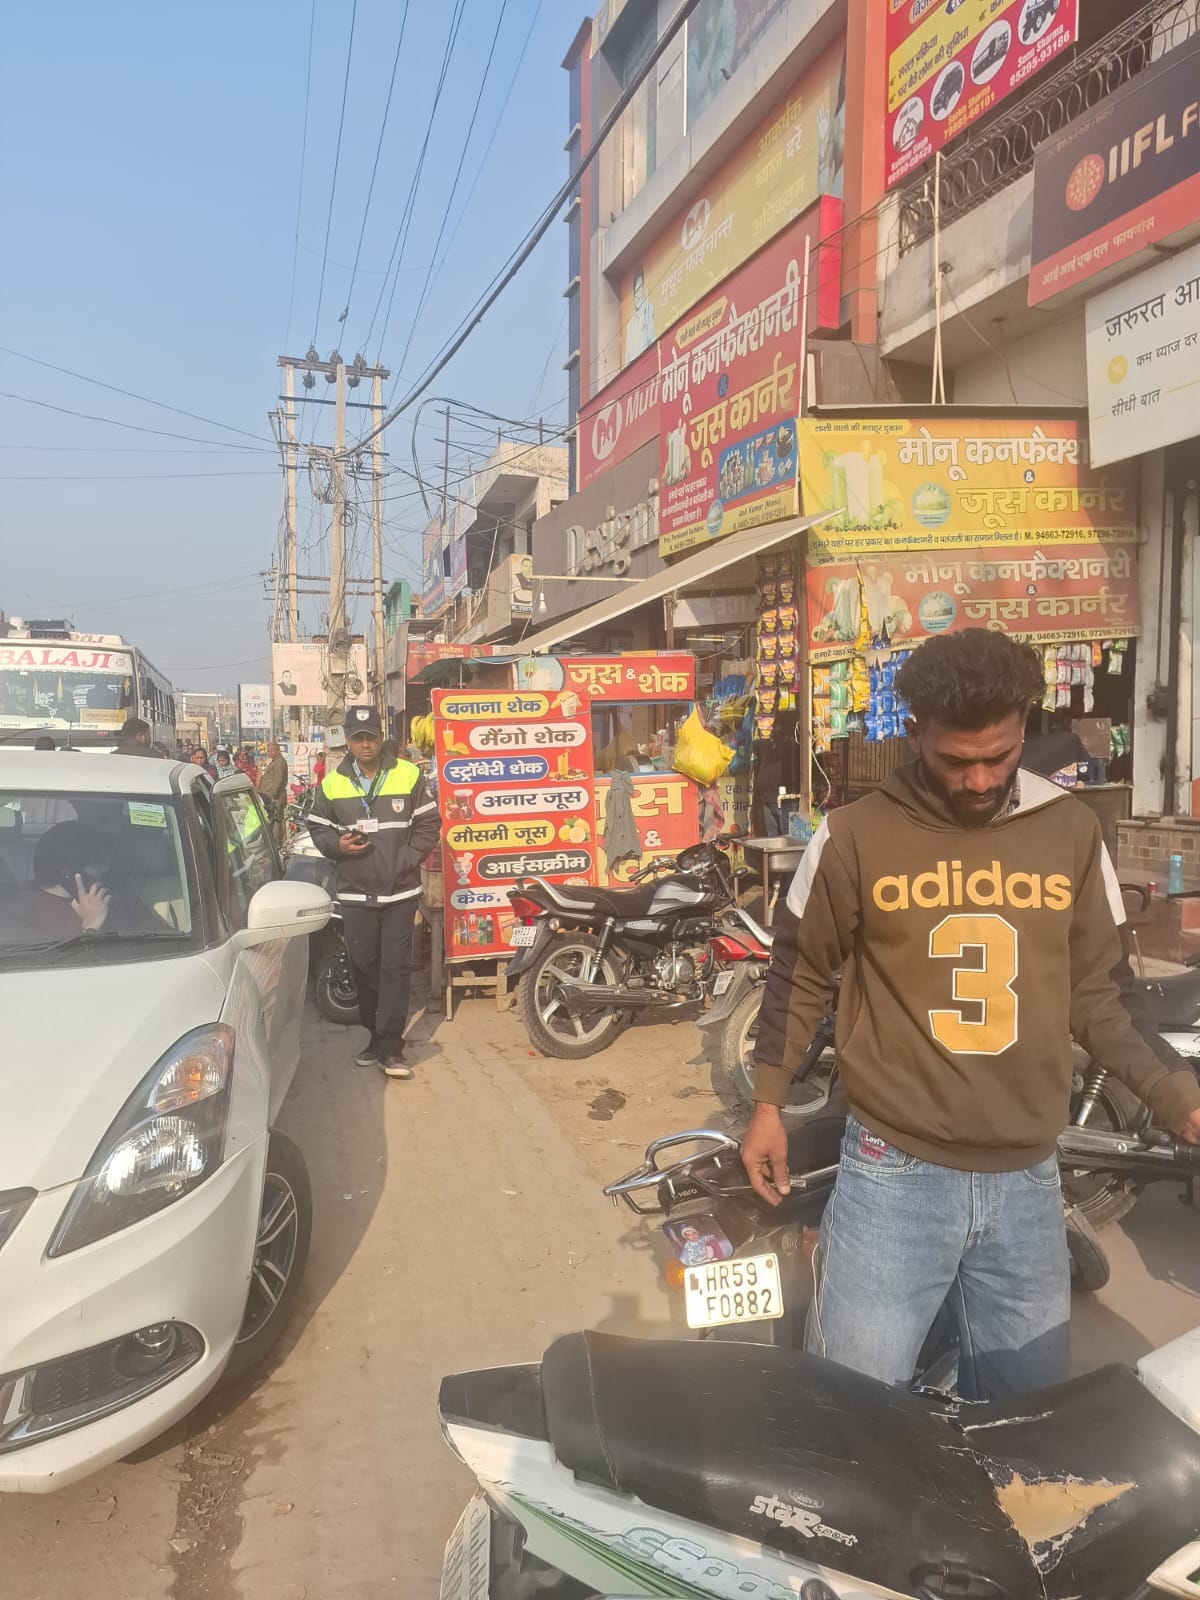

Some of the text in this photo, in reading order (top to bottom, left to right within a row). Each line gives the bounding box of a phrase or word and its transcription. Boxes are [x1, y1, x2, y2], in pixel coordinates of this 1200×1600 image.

[1108, 113, 1174, 185] IIFL
[1182, 101, 1199, 139] F
[1174, 276, 1200, 307] आ
[1136, 351, 1152, 367] कम
[1155, 339, 1181, 358] ब्याज
[661, 347, 693, 415] मोनू
[718, 374, 729, 397] &
[690, 352, 797, 469] जूस कार्नर
[1111, 387, 1162, 417] सीधी बात
[897, 426, 968, 481] मोनू
[1024, 470, 1035, 483] &
[956, 477, 1129, 529] जूस कार्नर
[1024, 532, 1034, 540] M.
[902, 554, 971, 595] मोनू
[1027, 585, 1036, 595] &
[962, 586, 1128, 632] जूस कार्नर
[567, 663, 690, 695] जूस & शेक
[445, 696, 542, 715] बनाना शेक
[479, 726, 577, 746] मैंगो शेक
[449, 759, 543, 782] स्ट्रॉबेरी शेक
[482, 791, 582, 809] अनार जूस
[453, 824, 547, 845] मौसमी जूस
[644, 830, 663, 847] &
[485, 853, 586, 875] आईसक्रीम
[872, 860, 1072, 912] adidas
[928, 913, 1018, 1055] 3
[706, 1262, 758, 1293] HR59
[706, 1288, 773, 1321] F0882
